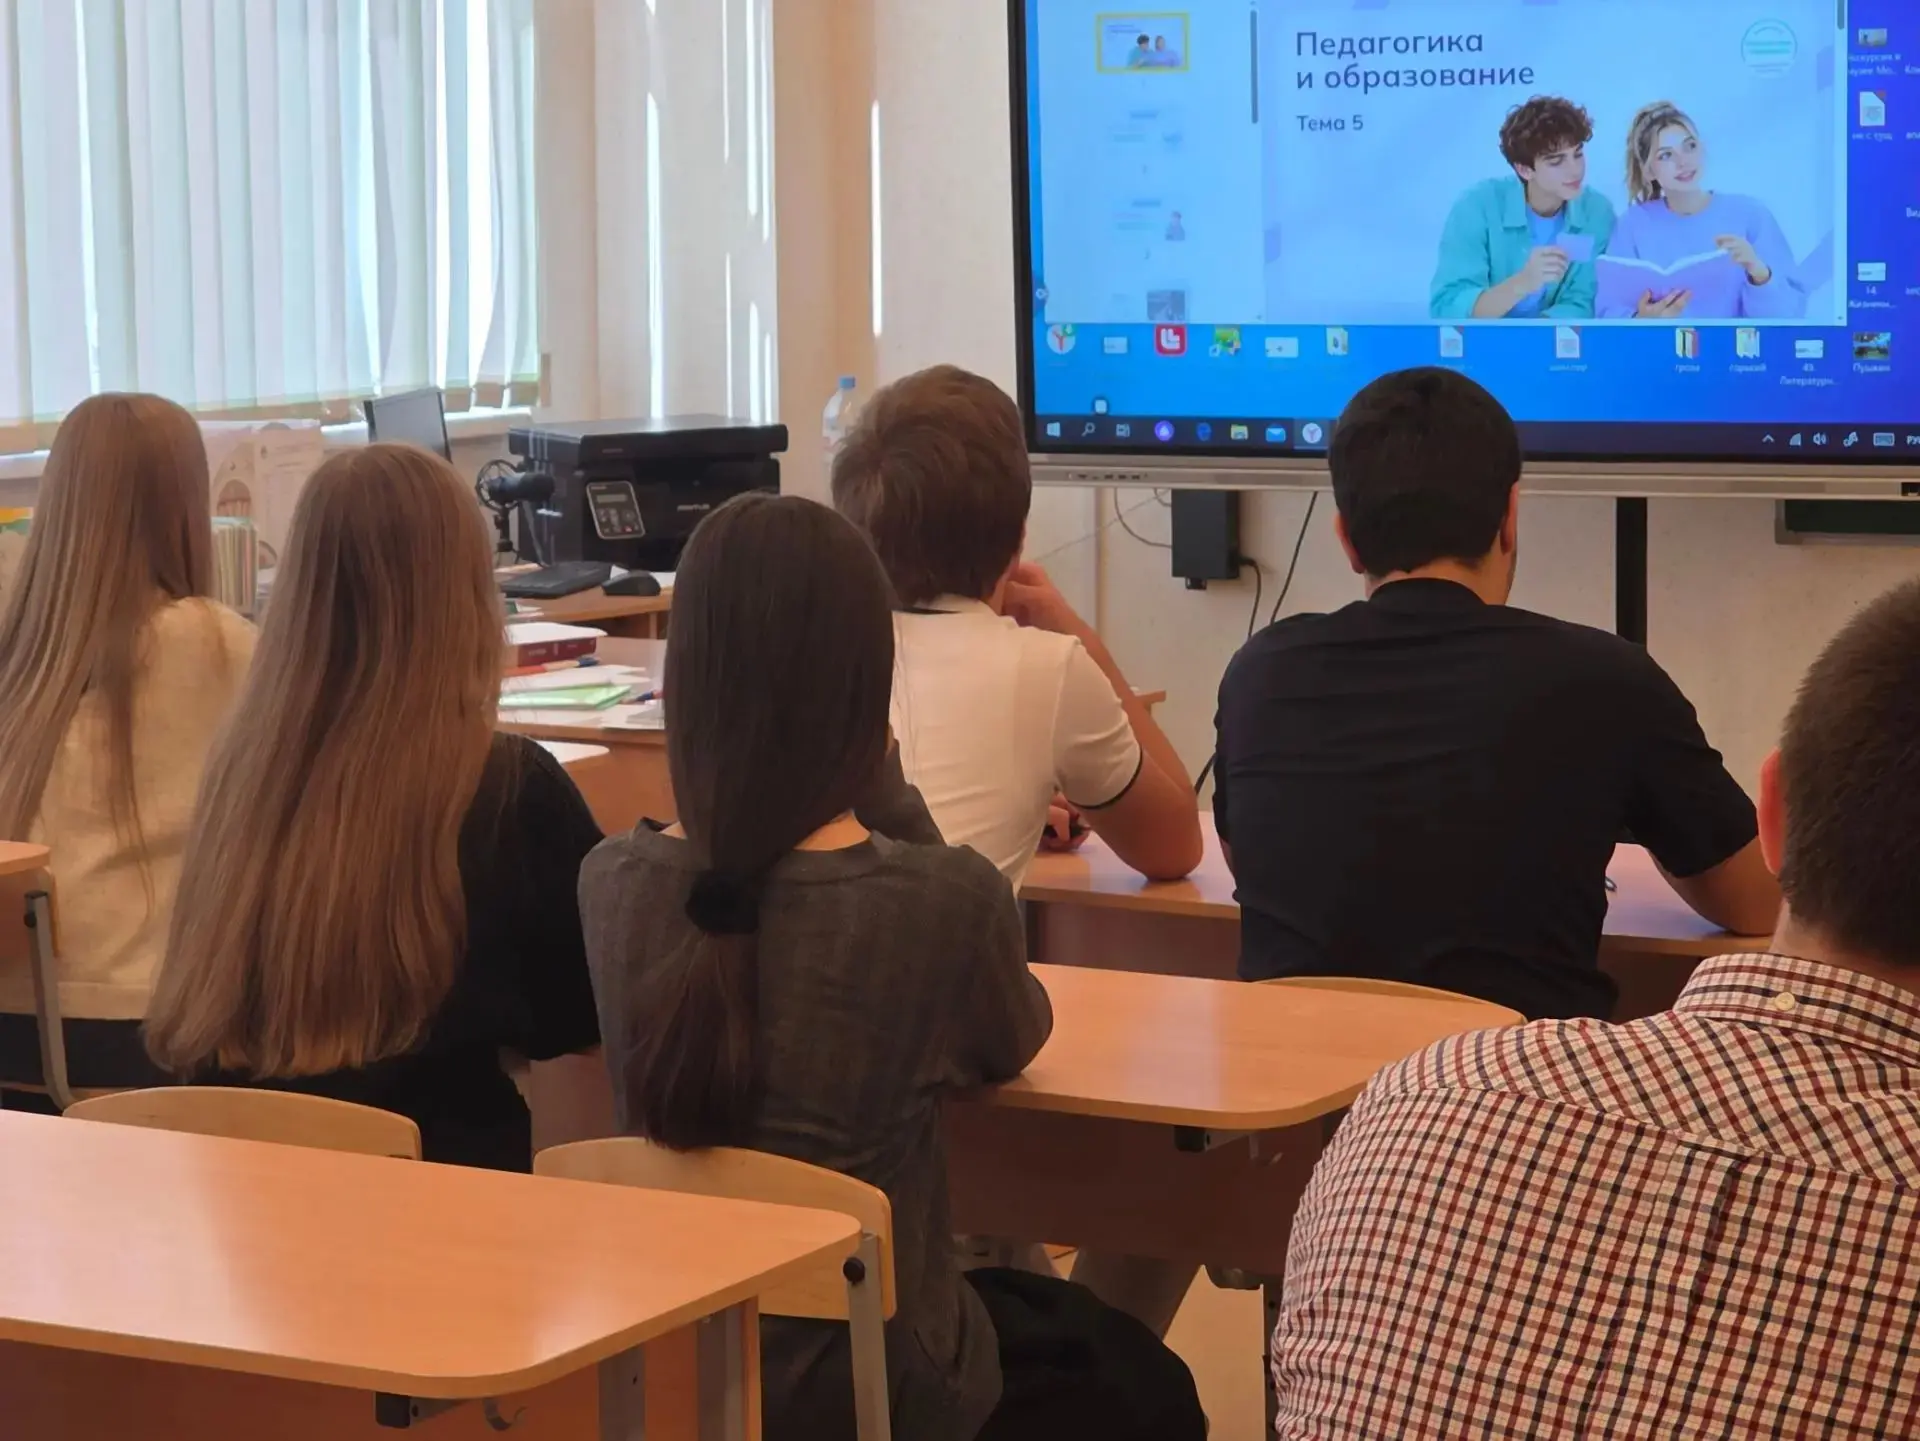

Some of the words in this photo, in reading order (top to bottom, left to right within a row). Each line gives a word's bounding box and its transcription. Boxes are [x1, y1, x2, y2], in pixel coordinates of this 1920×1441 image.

[1296, 32, 1484, 59] Педагогика
[1297, 71, 1313, 89] и
[1324, 63, 1535, 94] образование
[1297, 115, 1345, 131] Тема
[1352, 114, 1364, 131] 5
